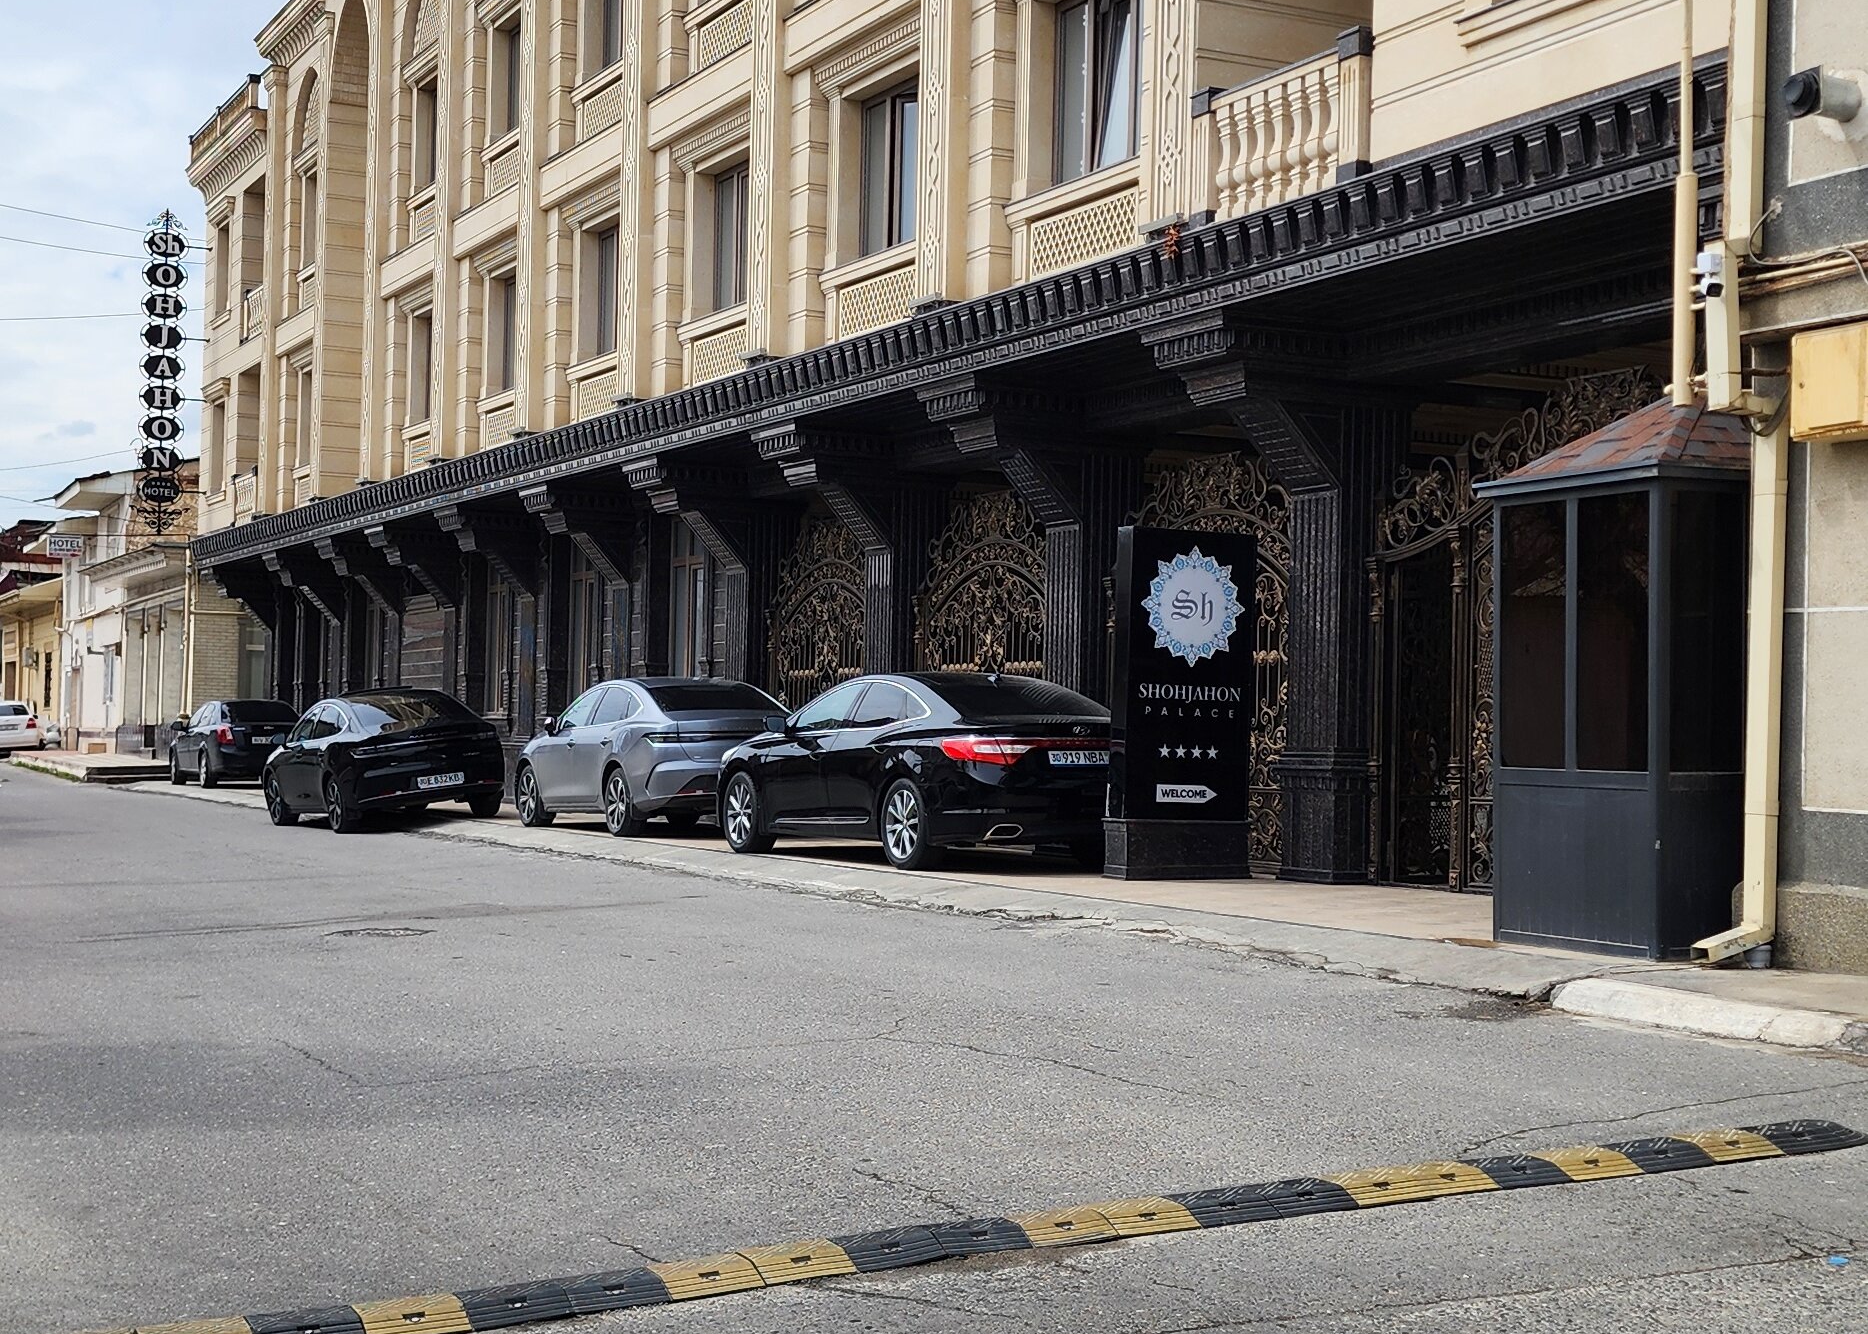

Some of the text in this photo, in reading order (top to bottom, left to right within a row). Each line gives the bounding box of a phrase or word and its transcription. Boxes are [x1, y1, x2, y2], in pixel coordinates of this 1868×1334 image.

[144, 487, 177, 497] HOTEL
[50, 539, 82, 548] HOTEL
[1171, 588, 1214, 627] Sh
[1138, 682, 1241, 704] SHOHJAHON
[1145, 705, 1235, 719] PALACE
[1062, 751, 1081, 764] 919
[1083, 751, 1106, 764] NBA
[1161, 788, 1208, 799] WELCOME
